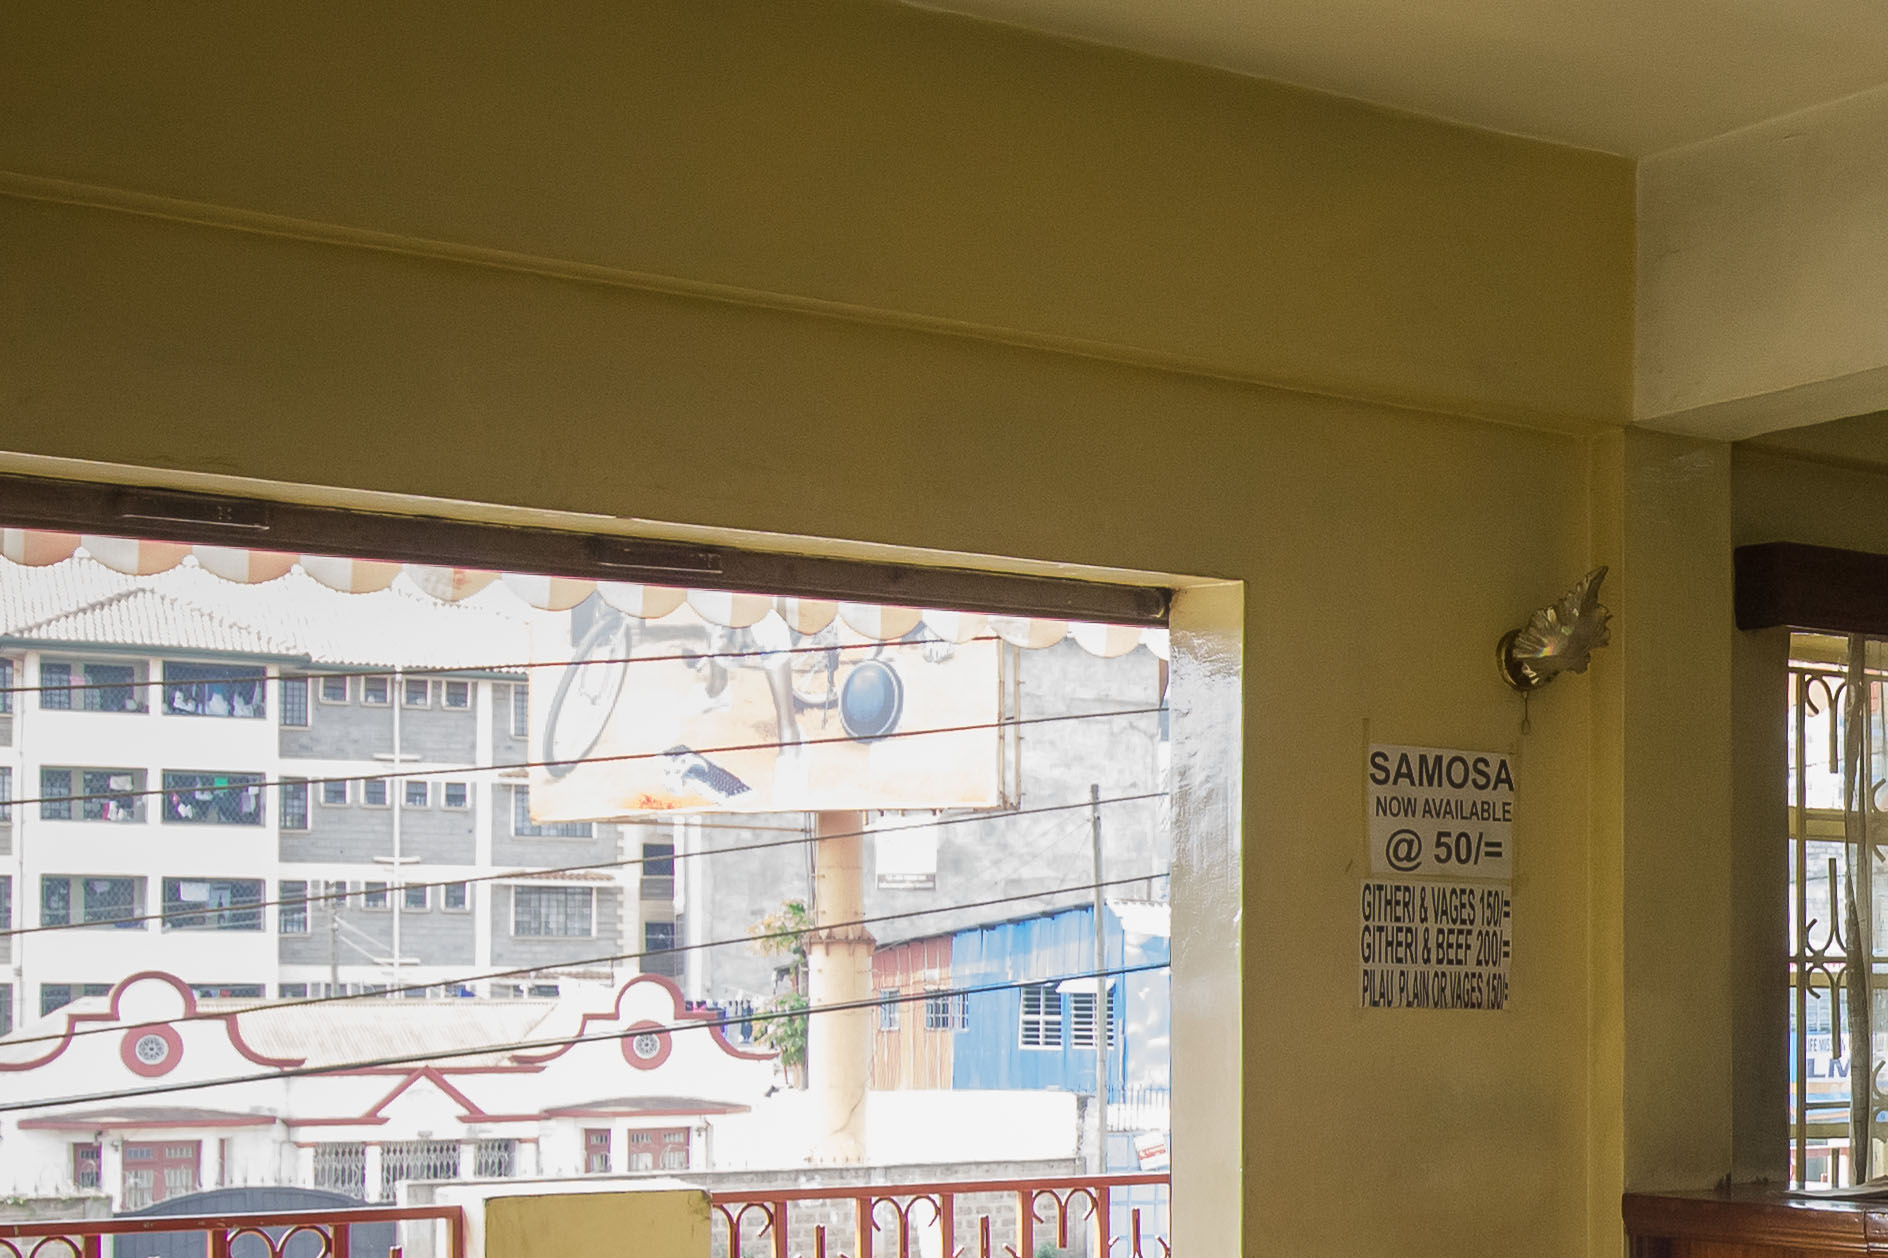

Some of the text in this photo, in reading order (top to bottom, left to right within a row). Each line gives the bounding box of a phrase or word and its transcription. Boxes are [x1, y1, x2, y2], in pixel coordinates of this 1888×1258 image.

[1369, 751, 1515, 792] SAMOSA
[1375, 795, 1513, 822] NOW AVAILABLE
[1385, 828, 1503, 872] @ 50/=
[1361, 883, 1511, 927] GITHERI & VAGES 150/=
[1360, 925, 1511, 968] GITHERI & BEEF 200/=
[1362, 968, 1394, 1008] PILAU
[1399, 969, 1430, 1009] PLAIN
[1432, 970, 1447, 1009] OR
[1450, 971, 1483, 1009] VAGES
